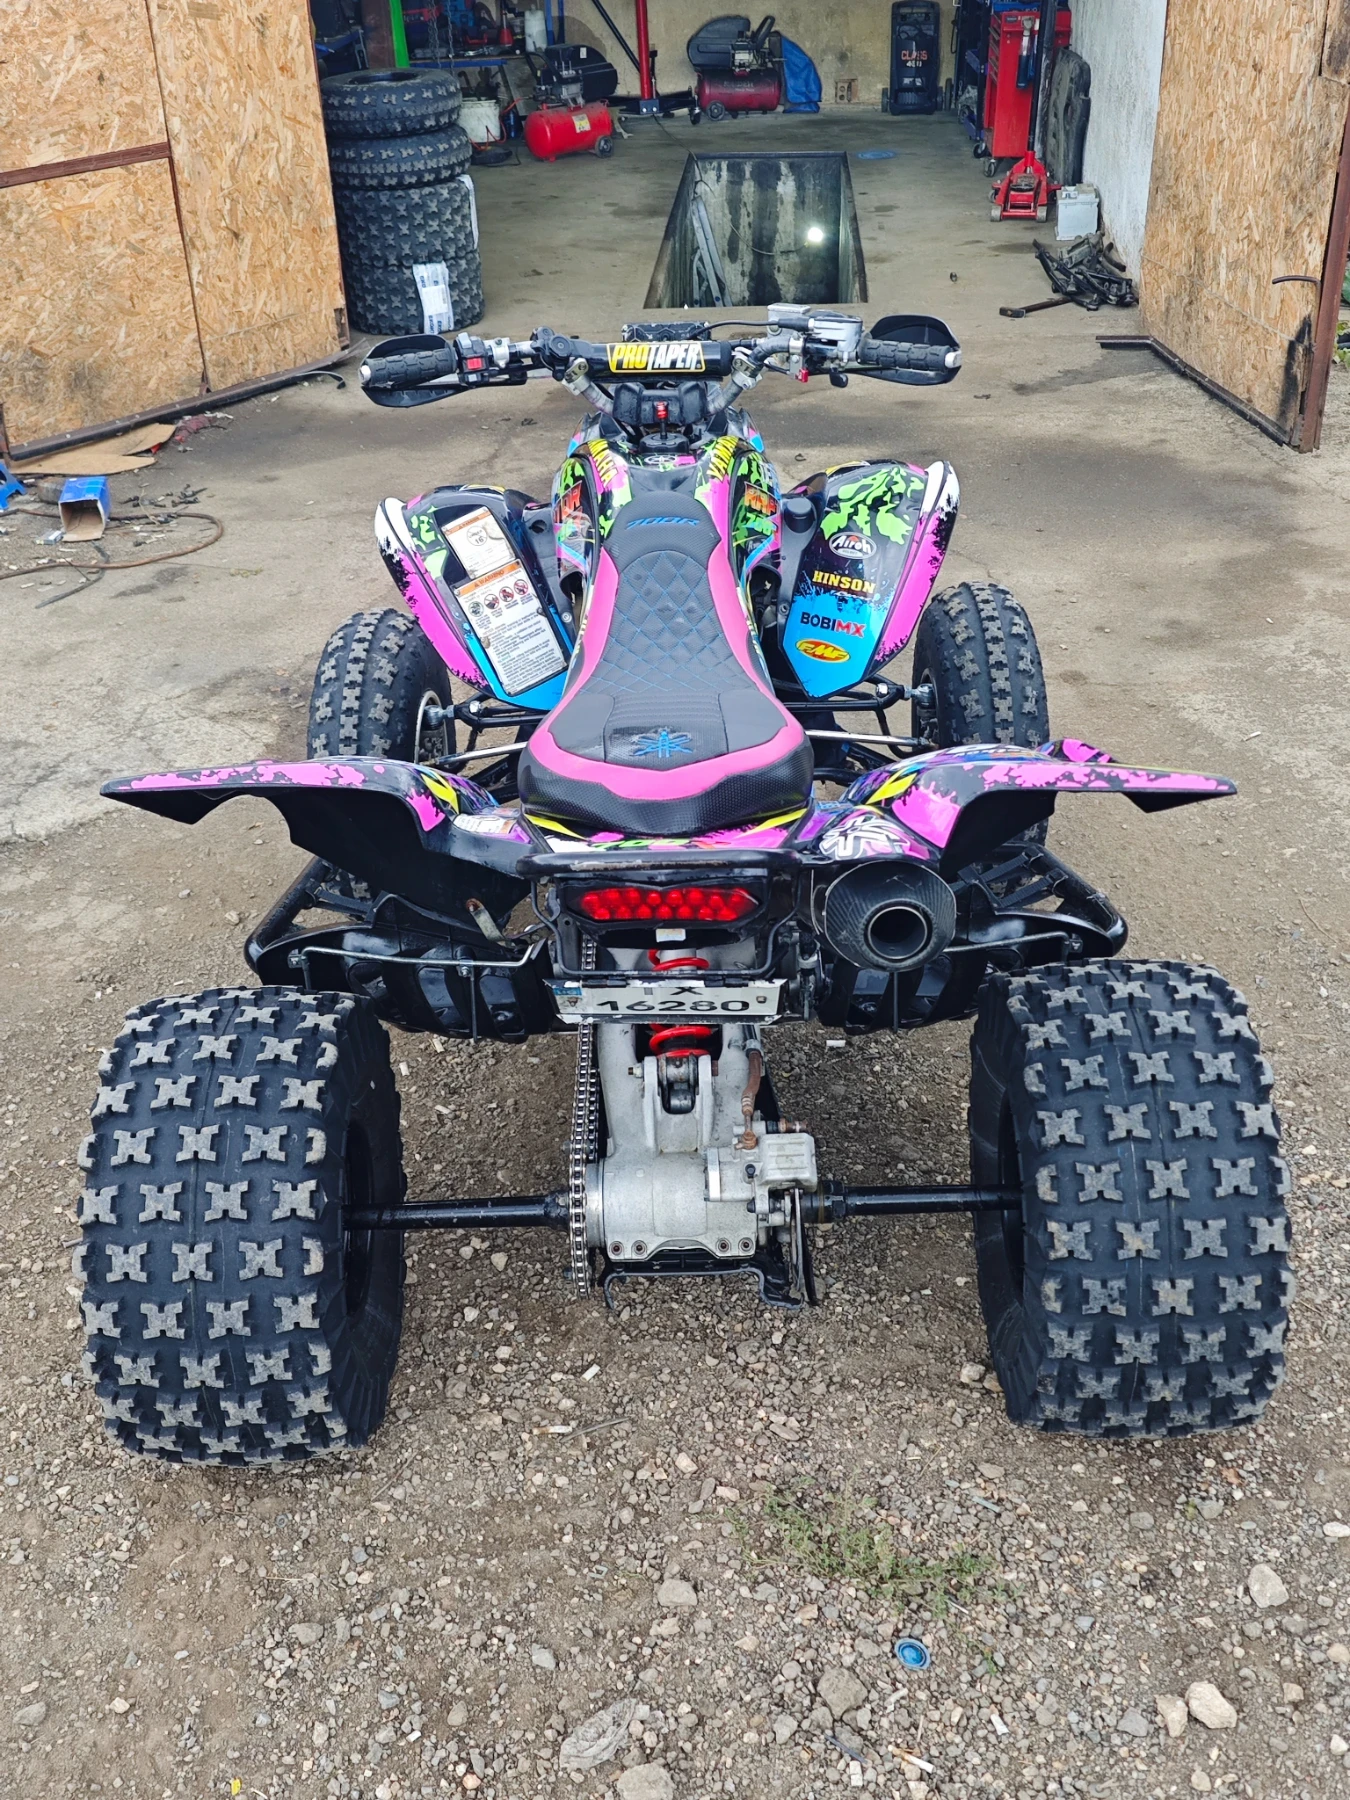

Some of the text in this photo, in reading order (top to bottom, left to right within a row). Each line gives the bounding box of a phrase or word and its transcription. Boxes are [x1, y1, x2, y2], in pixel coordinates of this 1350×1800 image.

[609, 343, 701, 372] PROTAPER
[587, 438, 618, 488] AMAHA
[475, 536, 485, 545] 16
[832, 535, 872, 554] Airoh
[812, 570, 877, 594] HINSON
[800, 611, 866, 638] BOBIMX
[597, 1000, 750, 1012] 16280
